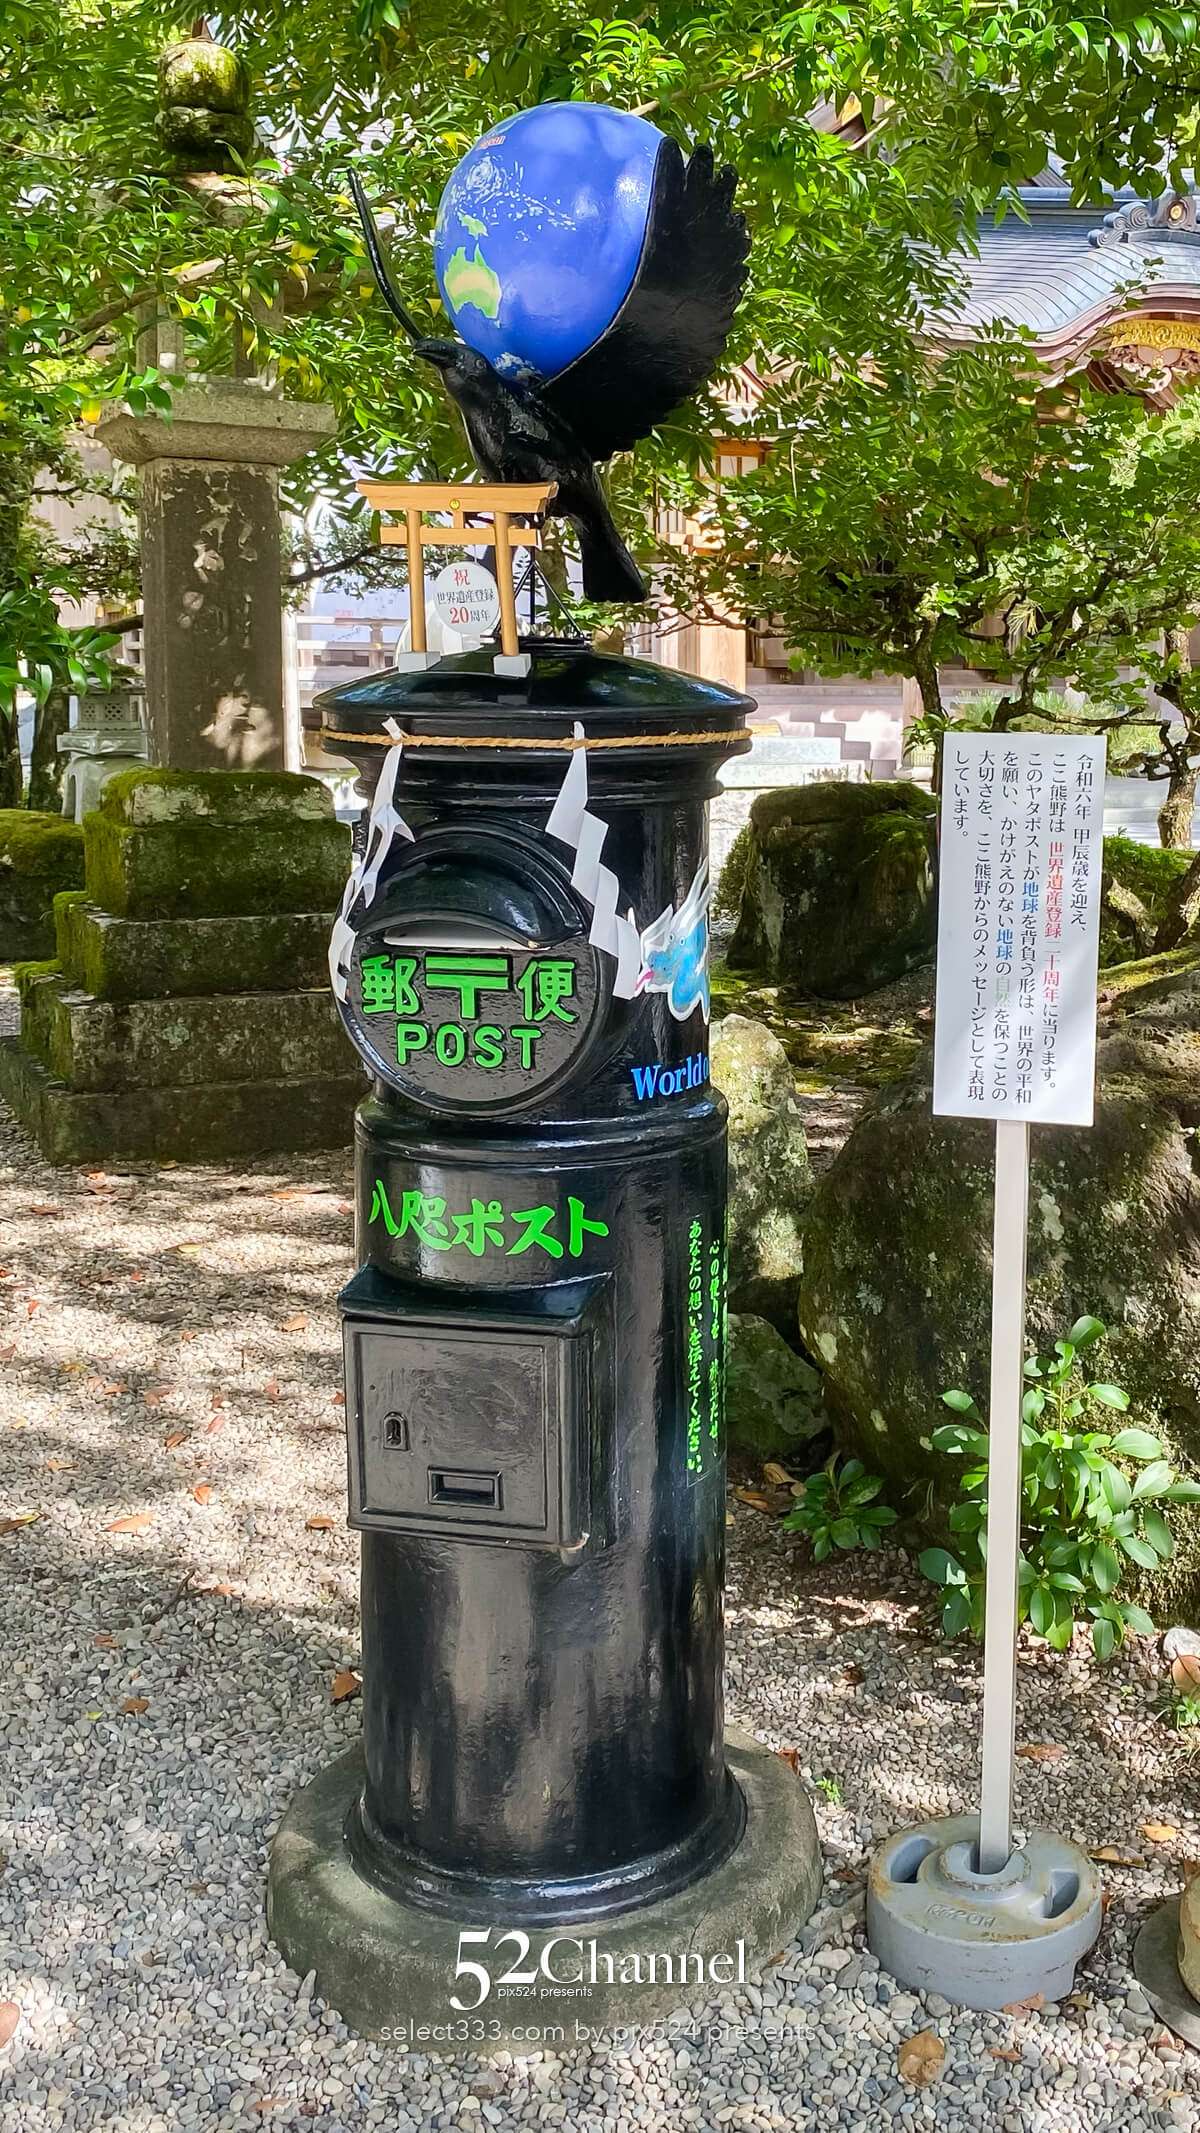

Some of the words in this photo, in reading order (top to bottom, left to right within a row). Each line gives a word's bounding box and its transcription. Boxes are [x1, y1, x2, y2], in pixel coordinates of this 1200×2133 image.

[454, 569, 471, 586] 祝
[953, 750, 970, 837] しています。
[396, 1024, 543, 1070] POST
[368, 1179, 609, 1258] 八咫ポスト
